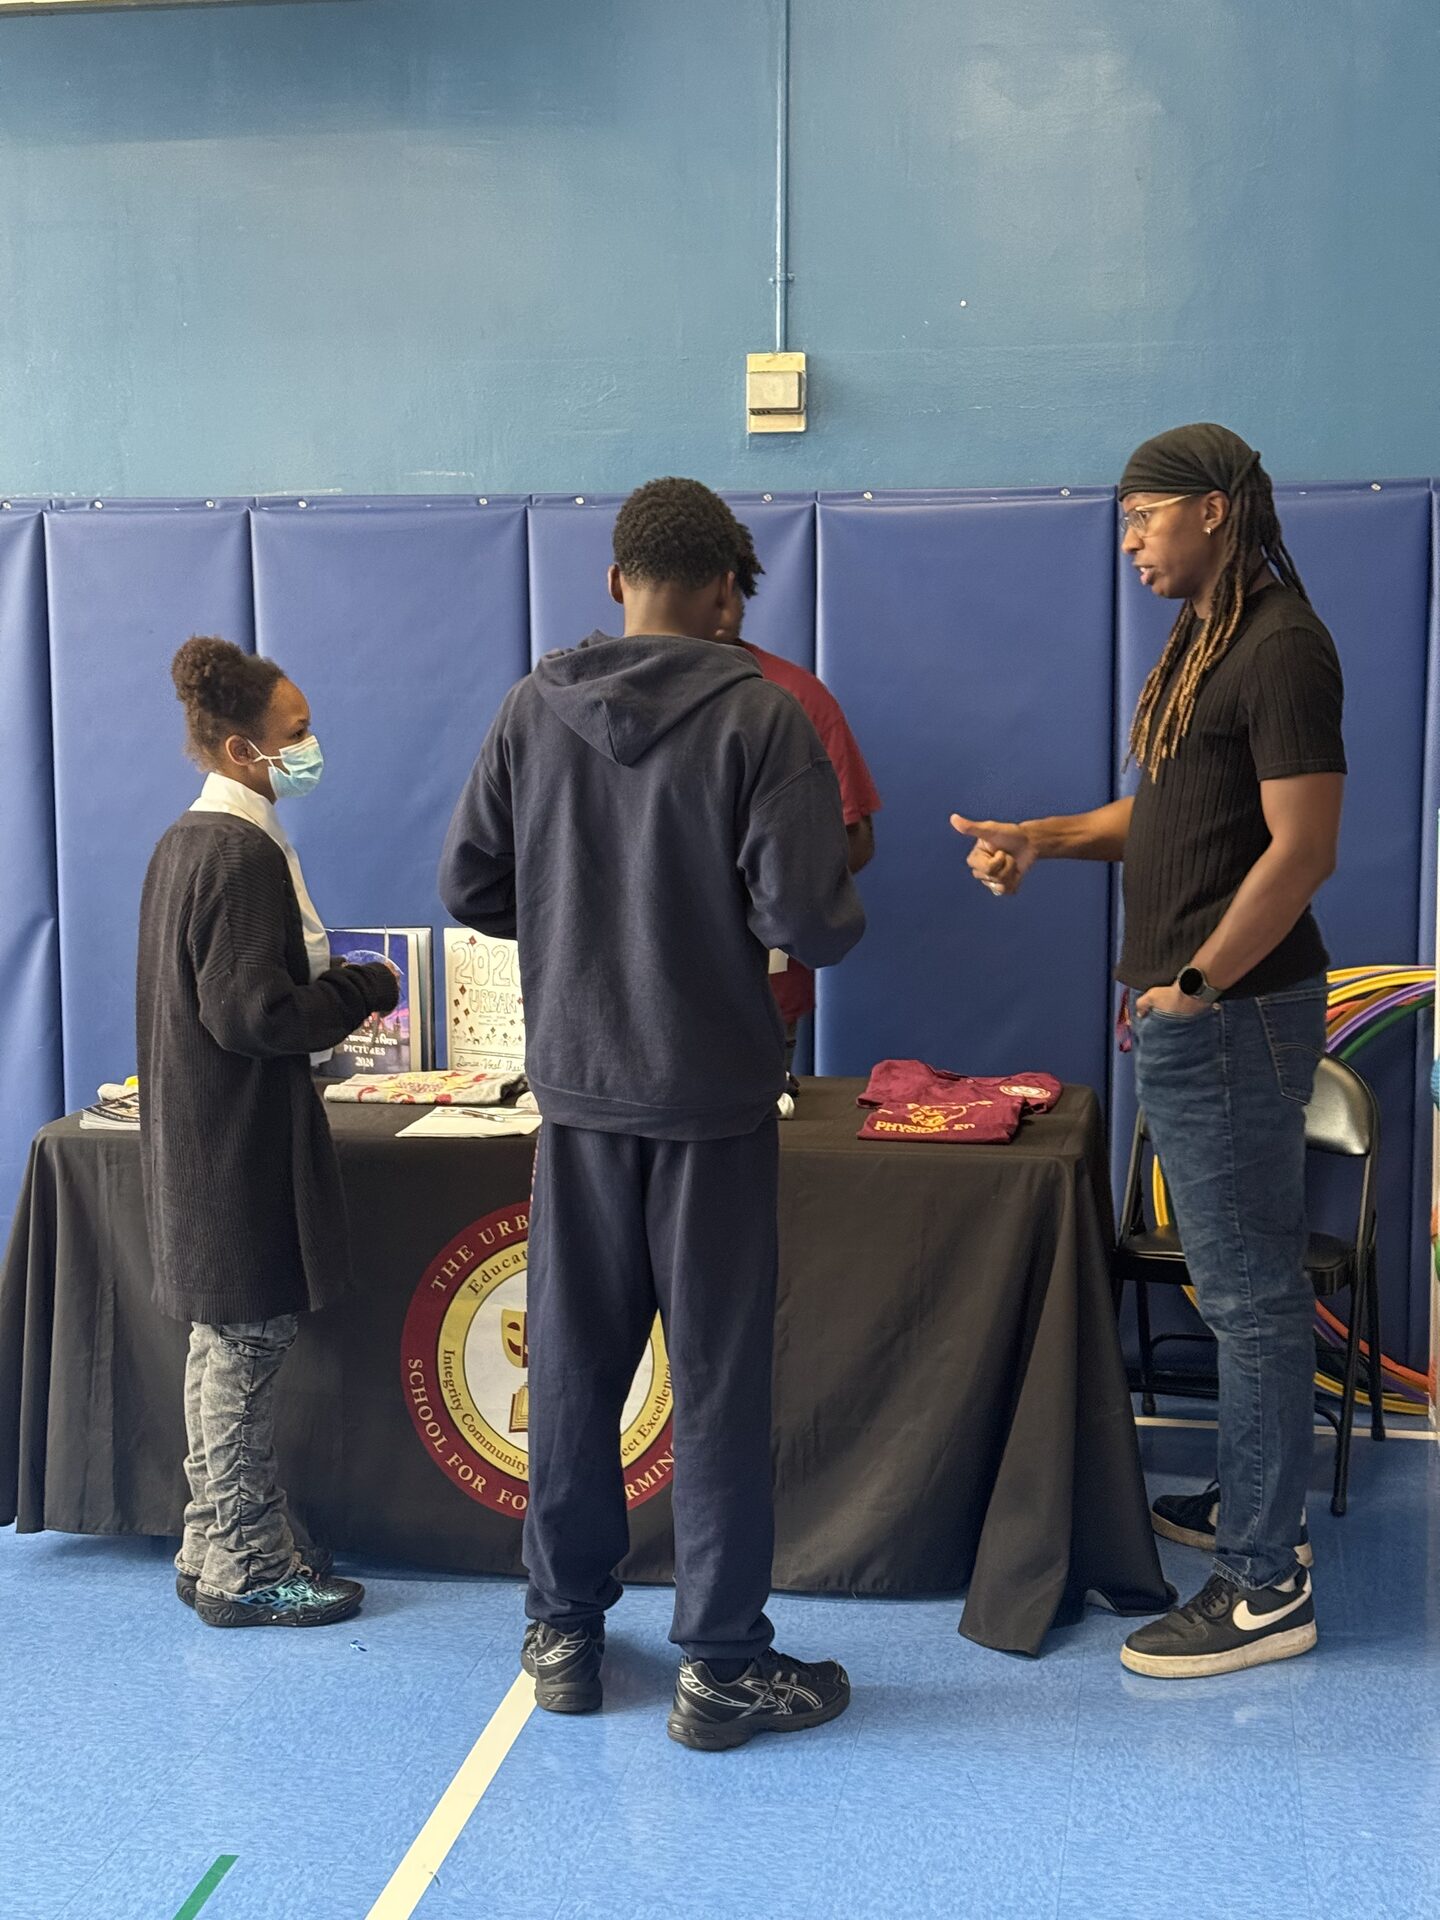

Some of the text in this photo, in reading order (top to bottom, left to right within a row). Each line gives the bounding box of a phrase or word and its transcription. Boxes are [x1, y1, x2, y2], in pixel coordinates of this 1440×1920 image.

[874, 1120, 949, 1134] PHYSICAL
[430, 1214, 529, 1292] THE URB
[467, 1249, 528, 1297] Educat
[408, 1358, 675, 1510] SCHOOL FOR FO RMIN
[443, 1348, 464, 1412] Integrity
[461, 1413, 529, 1475] Community
